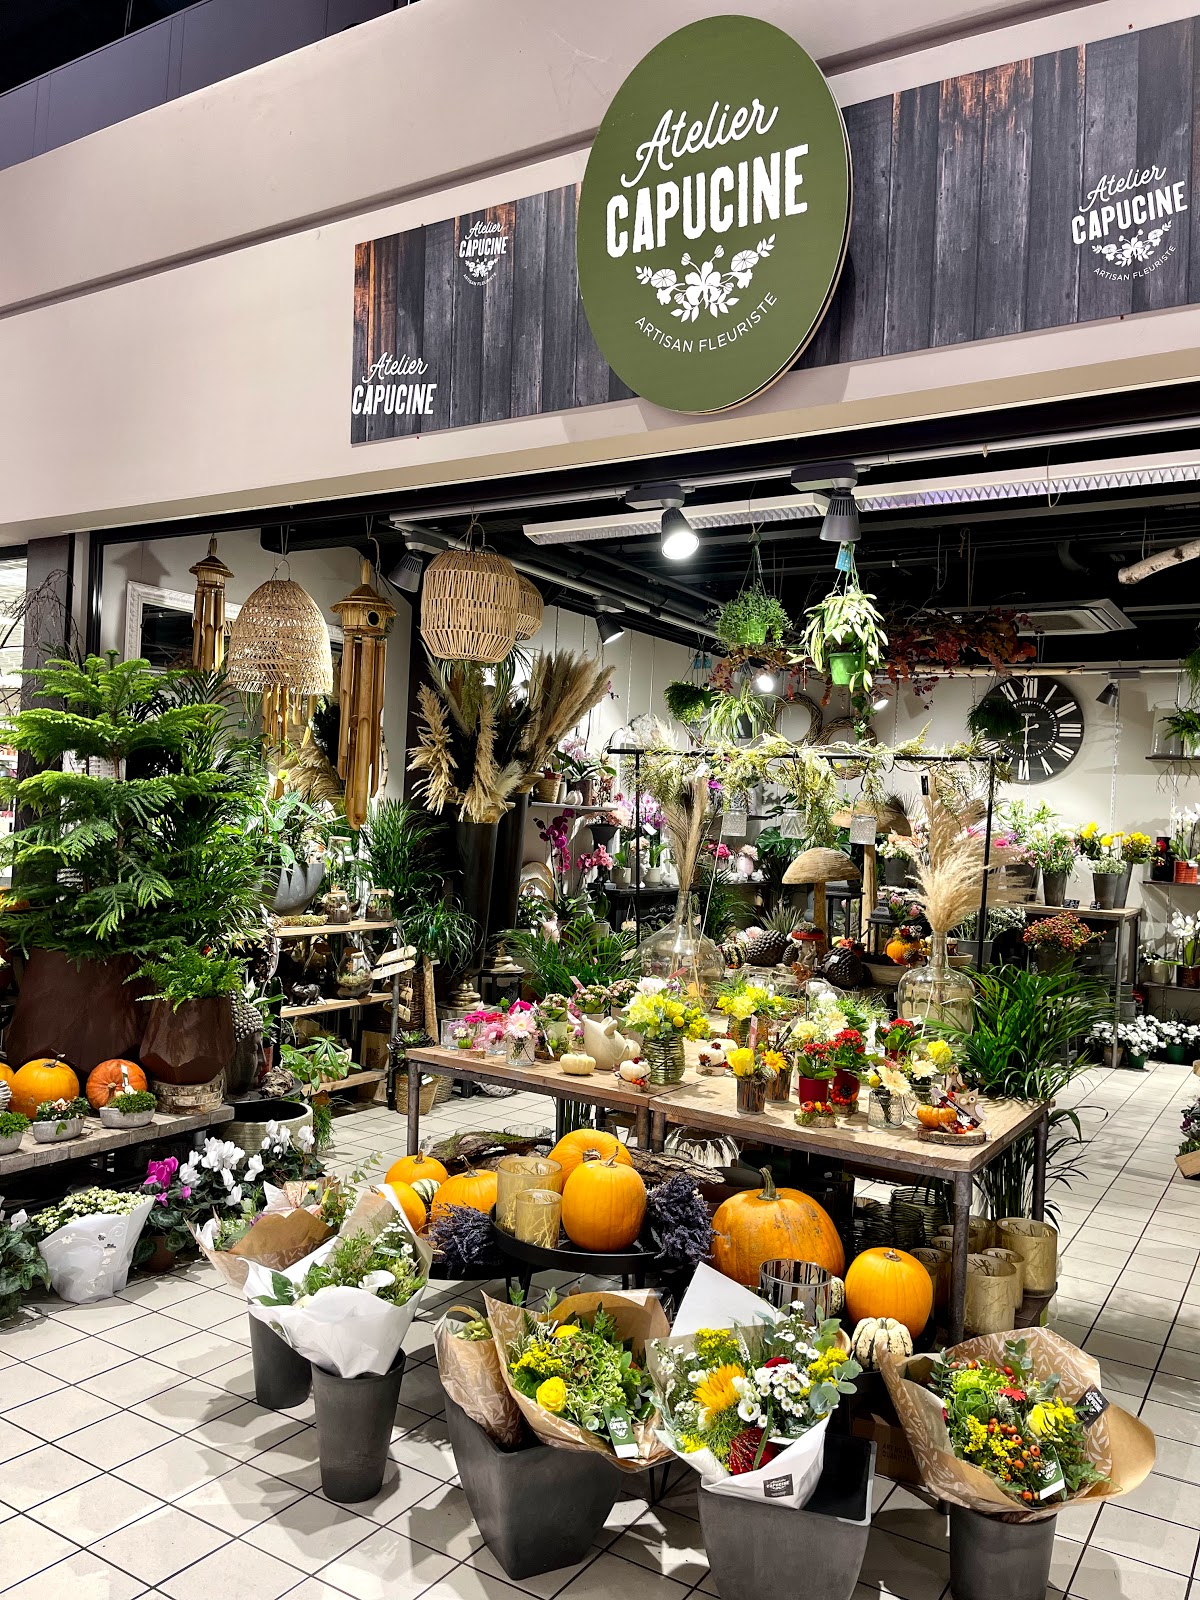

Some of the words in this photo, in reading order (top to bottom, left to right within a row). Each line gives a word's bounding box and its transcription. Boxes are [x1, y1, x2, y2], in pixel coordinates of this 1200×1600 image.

[620, 98, 779, 188] Atelier
[606, 143, 809, 258] CAPUCINE
[1078, 165, 1167, 213] Atelier
[464, 220, 504, 240] Atelier
[1071, 180, 1188, 245] CAPUCINE
[459, 236, 509, 258] CAPUCINE
[1093, 267, 1130, 281] ARTISAN
[1132, 245, 1176, 279] FLEURISTE
[634, 316, 693, 353] ARTISAN
[698, 291, 778, 353] FLEURISTE
[362, 352, 428, 383] Atelier
[352, 383, 437, 415] CAPUCINE
